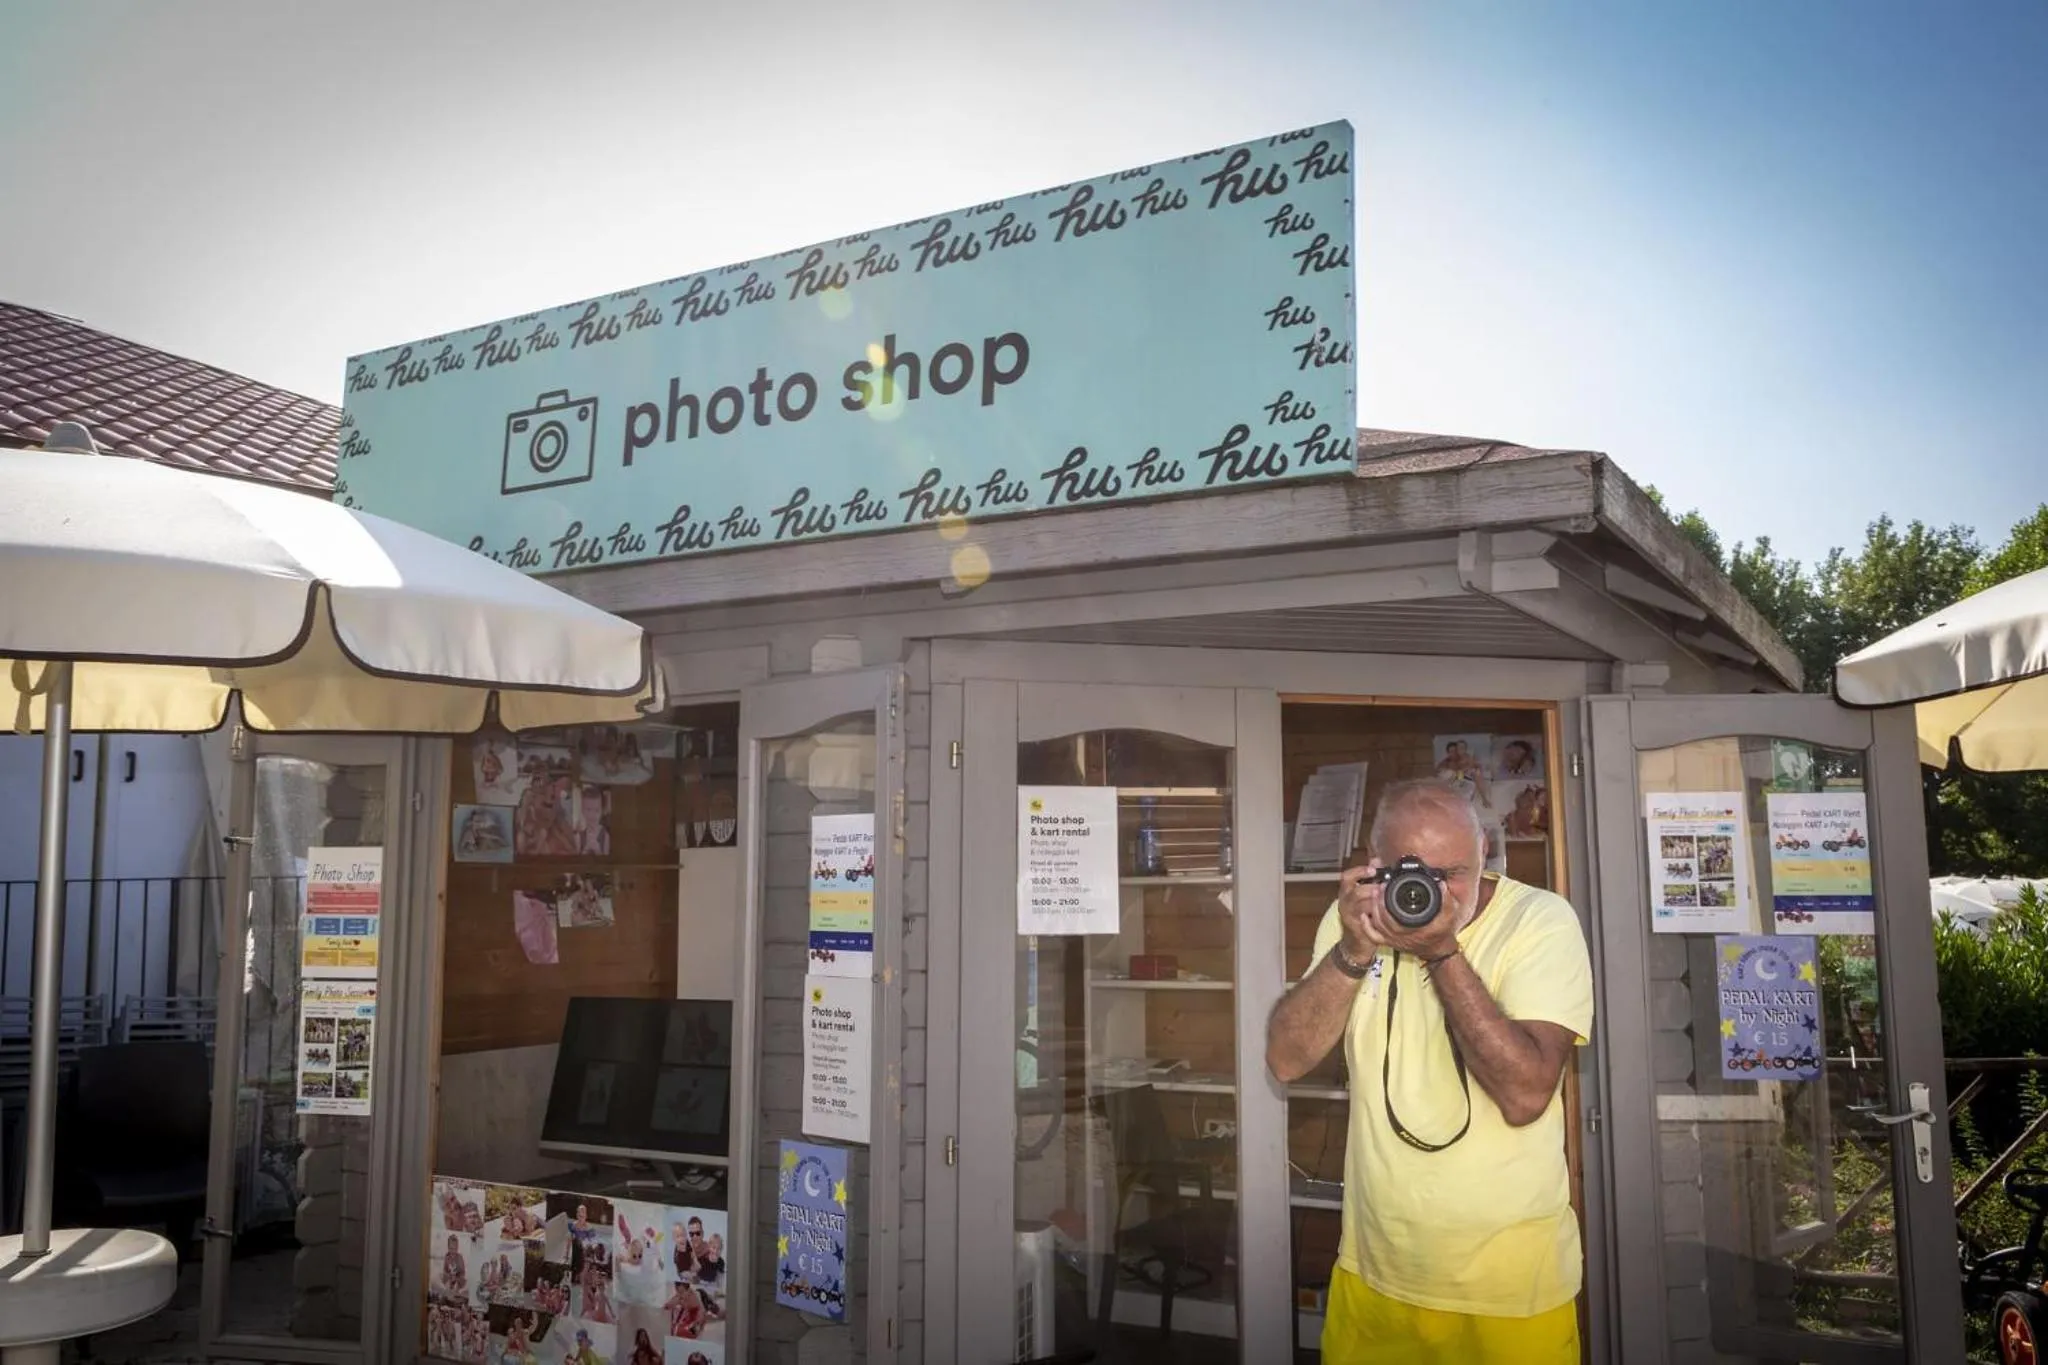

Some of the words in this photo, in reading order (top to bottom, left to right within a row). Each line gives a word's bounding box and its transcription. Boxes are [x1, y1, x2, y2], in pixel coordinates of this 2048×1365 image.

[1263, 202, 1316, 239] hu
[347, 363, 378, 394] hu
[384, 345, 430, 391] hu
[432, 343, 466, 375] hu
[472, 324, 521, 371] hu
[524, 322, 560, 354] hu
[567, 301, 621, 350] hu
[625, 298, 663, 332] hu
[671, 276, 730, 326] hu
[733, 272, 776, 307] hu
[785, 248, 850, 301] hu
[853, 243, 900, 280] hu
[910, 217, 982, 273] hu
[984, 211, 1037, 252] hu
[1047, 183, 1128, 243] hu
[1130, 177, 1189, 220] hu
[1199, 147, 1290, 210] hu
[1291, 139, 1351, 185] hu
[1292, 232, 1351, 277] hu
[1263, 295, 1316, 332] hu
[1292, 326, 1352, 371] hu
[622, 367, 818, 474] photo
[841, 332, 1030, 414] shop
[1263, 389, 1317, 426] hu
[340, 429, 372, 460] hu
[505, 537, 542, 568] hu
[549, 520, 605, 569] hu
[606, 521, 647, 557] hu
[654, 504, 715, 556] hu
[717, 505, 761, 542] hu
[770, 486, 837, 540] hu
[840, 487, 888, 526] hu
[898, 467, 972, 524] hu
[975, 468, 1029, 508] hu
[1040, 446, 1122, 506] hu
[1125, 446, 1185, 489] hu
[1197, 423, 1289, 486] hu
[1293, 423, 1353, 467] hu
[1031, 816, 1059, 824] Photo
[1062, 816, 1085, 825] shop
[1031, 827, 1038, 836] &
[1040, 827, 1059, 836] kart
[1062, 827, 1090, 836] rental
[313, 864, 343, 882] Photo
[347, 863, 375, 883] Shop
[1721, 990, 1769, 1006] PEDAL
[1773, 991, 1815, 1006] KART
[812, 1006, 832, 1017] Photo
[834, 1008, 852, 1021] shop
[812, 1020, 817, 1029] &
[819, 1020, 833, 1030] kart
[834, 1021, 856, 1033] rental
[1739, 1007, 1757, 1028] by
[1762, 1007, 1800, 1028] Night
[1754, 1031, 1766, 1045] €
[1771, 1032, 1789, 1046] 15
[781, 1203, 812, 1226] PEDAL
[815, 1211, 846, 1233] KART
[790, 1224, 803, 1249] by
[807, 1230, 833, 1254] Night
[799, 1253, 808, 1271] €
[811, 1256, 823, 1276] 15
